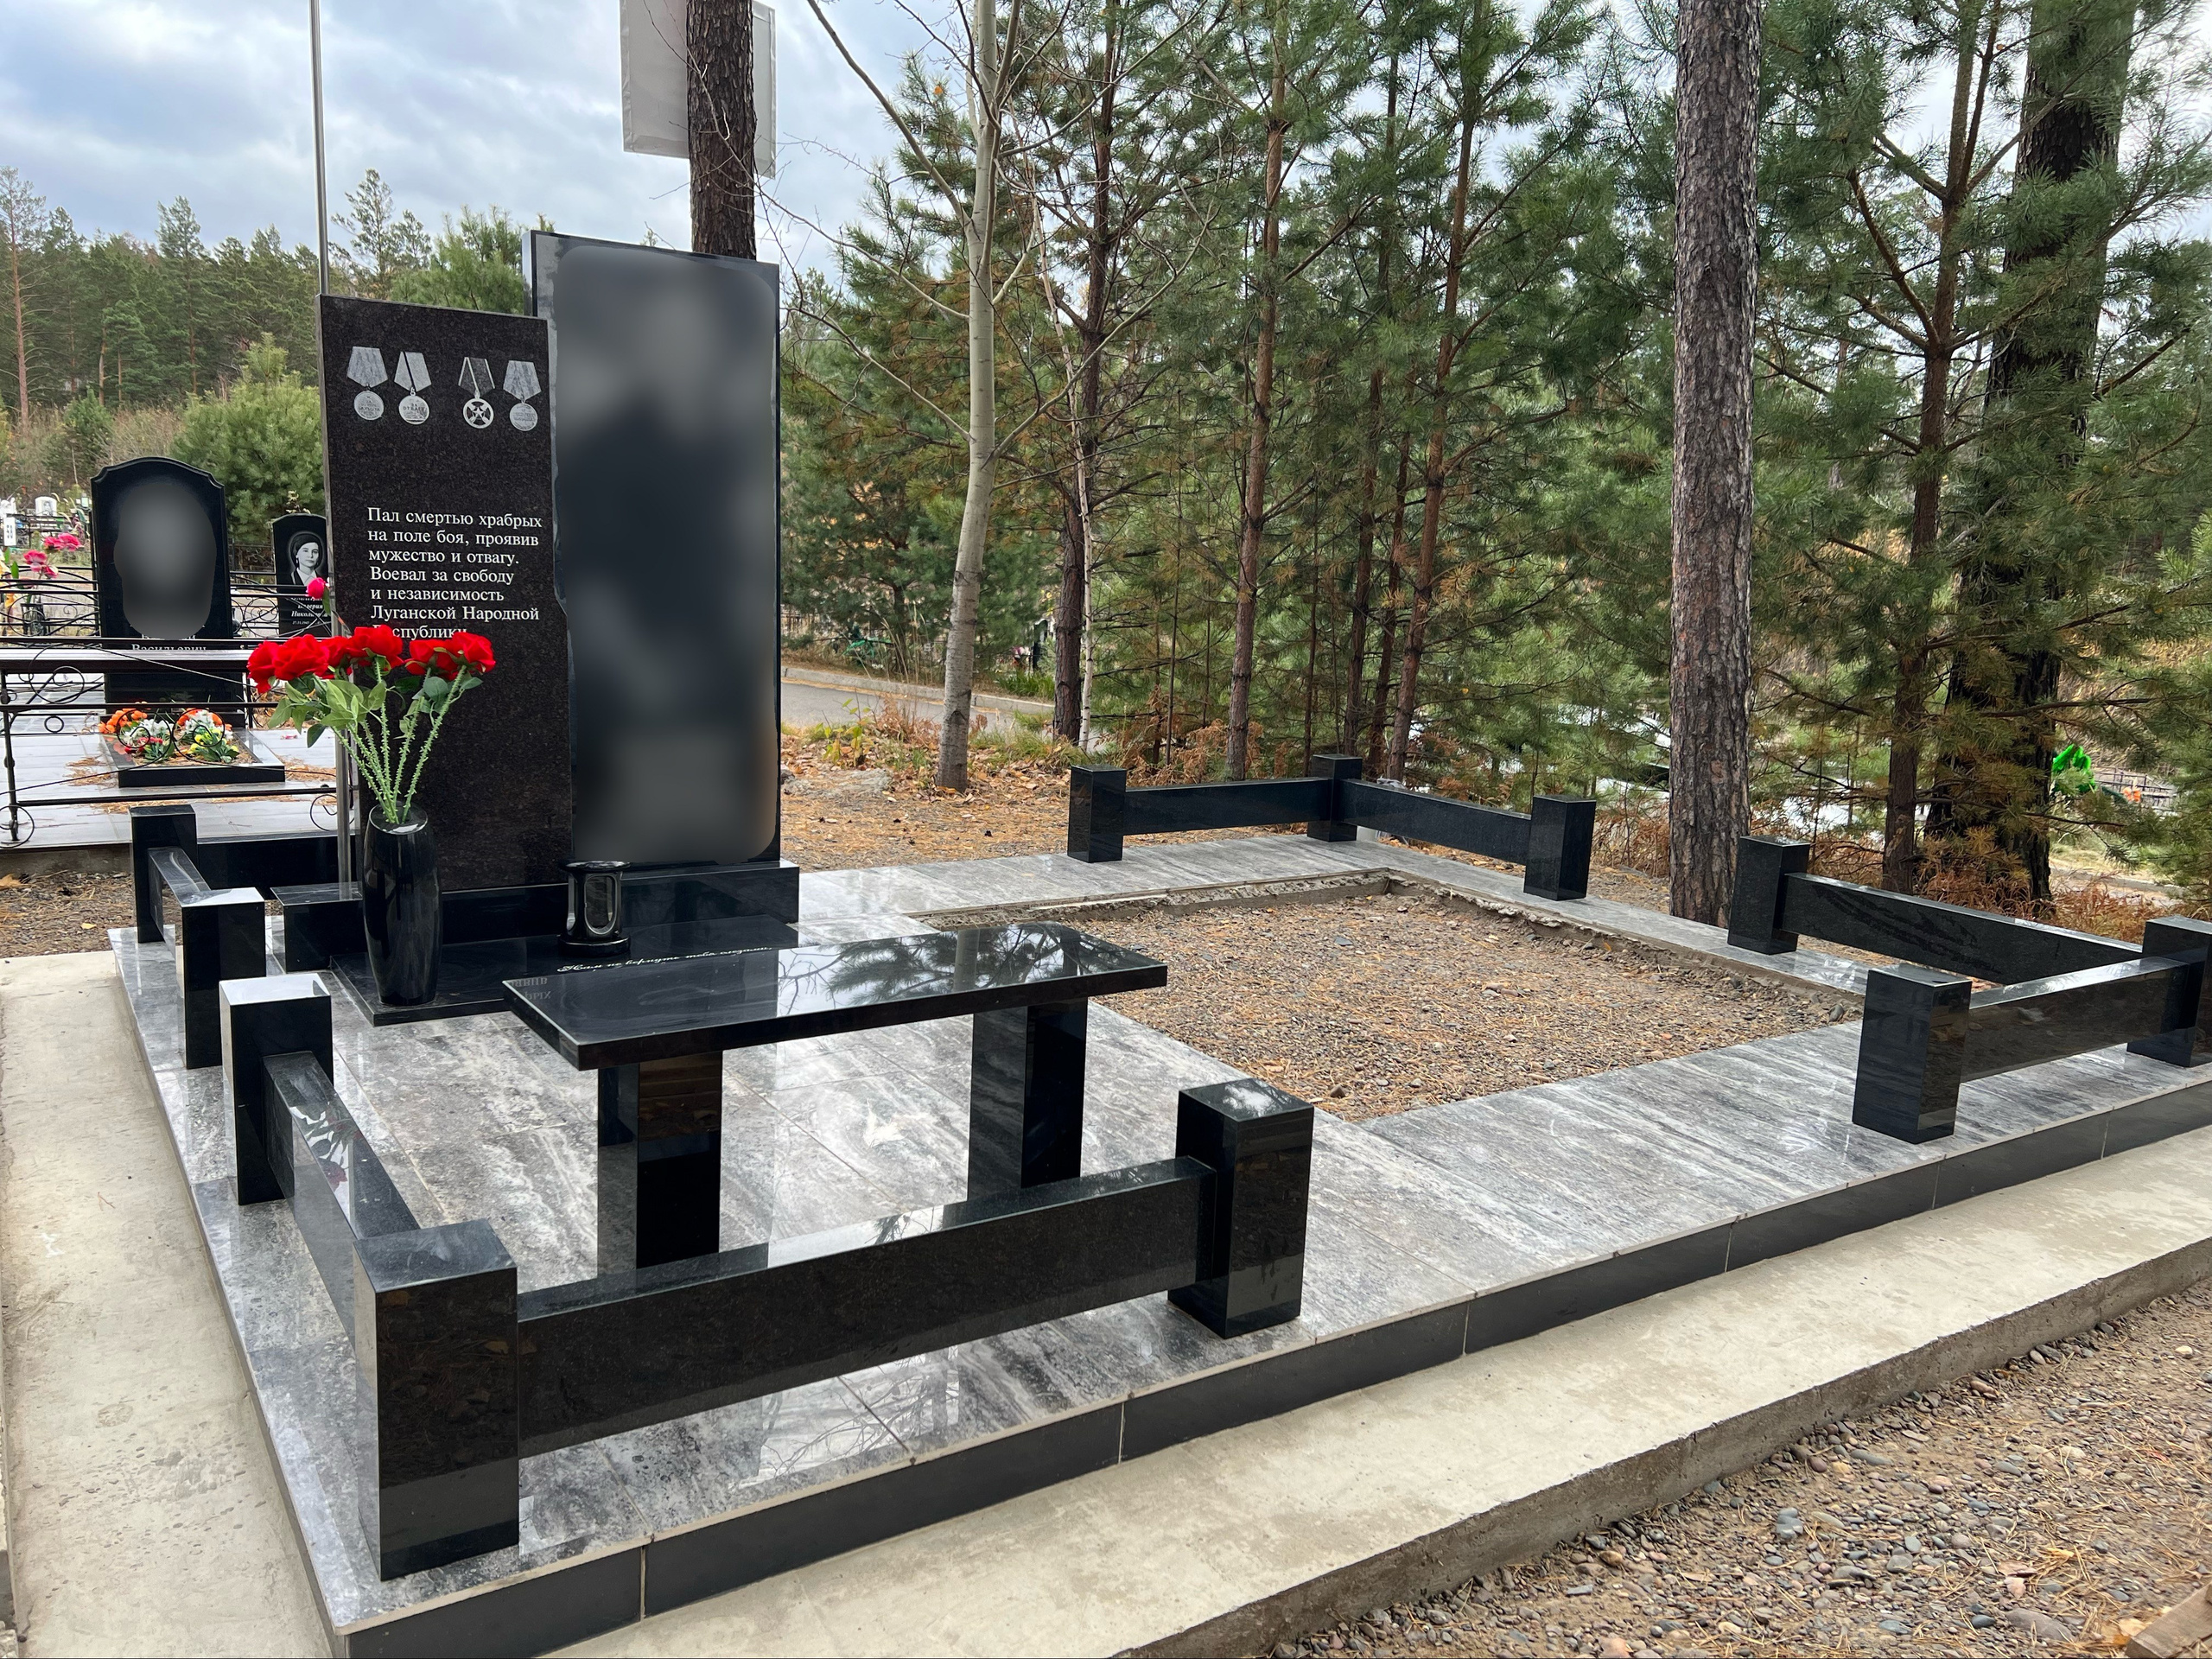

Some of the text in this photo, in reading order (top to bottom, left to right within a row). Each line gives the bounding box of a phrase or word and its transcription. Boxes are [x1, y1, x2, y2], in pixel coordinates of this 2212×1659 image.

[367, 506, 543, 530] Пал смертью храбрых
[367, 530, 538, 547] на поле боя, проявив
[368, 550, 519, 567] мужество и отвагу.
[370, 566, 514, 585] Воевал за свободу
[371, 589, 505, 601] и независимость
[371, 605, 540, 622] Луганской Народной
[372, 624, 467, 640] спублик
